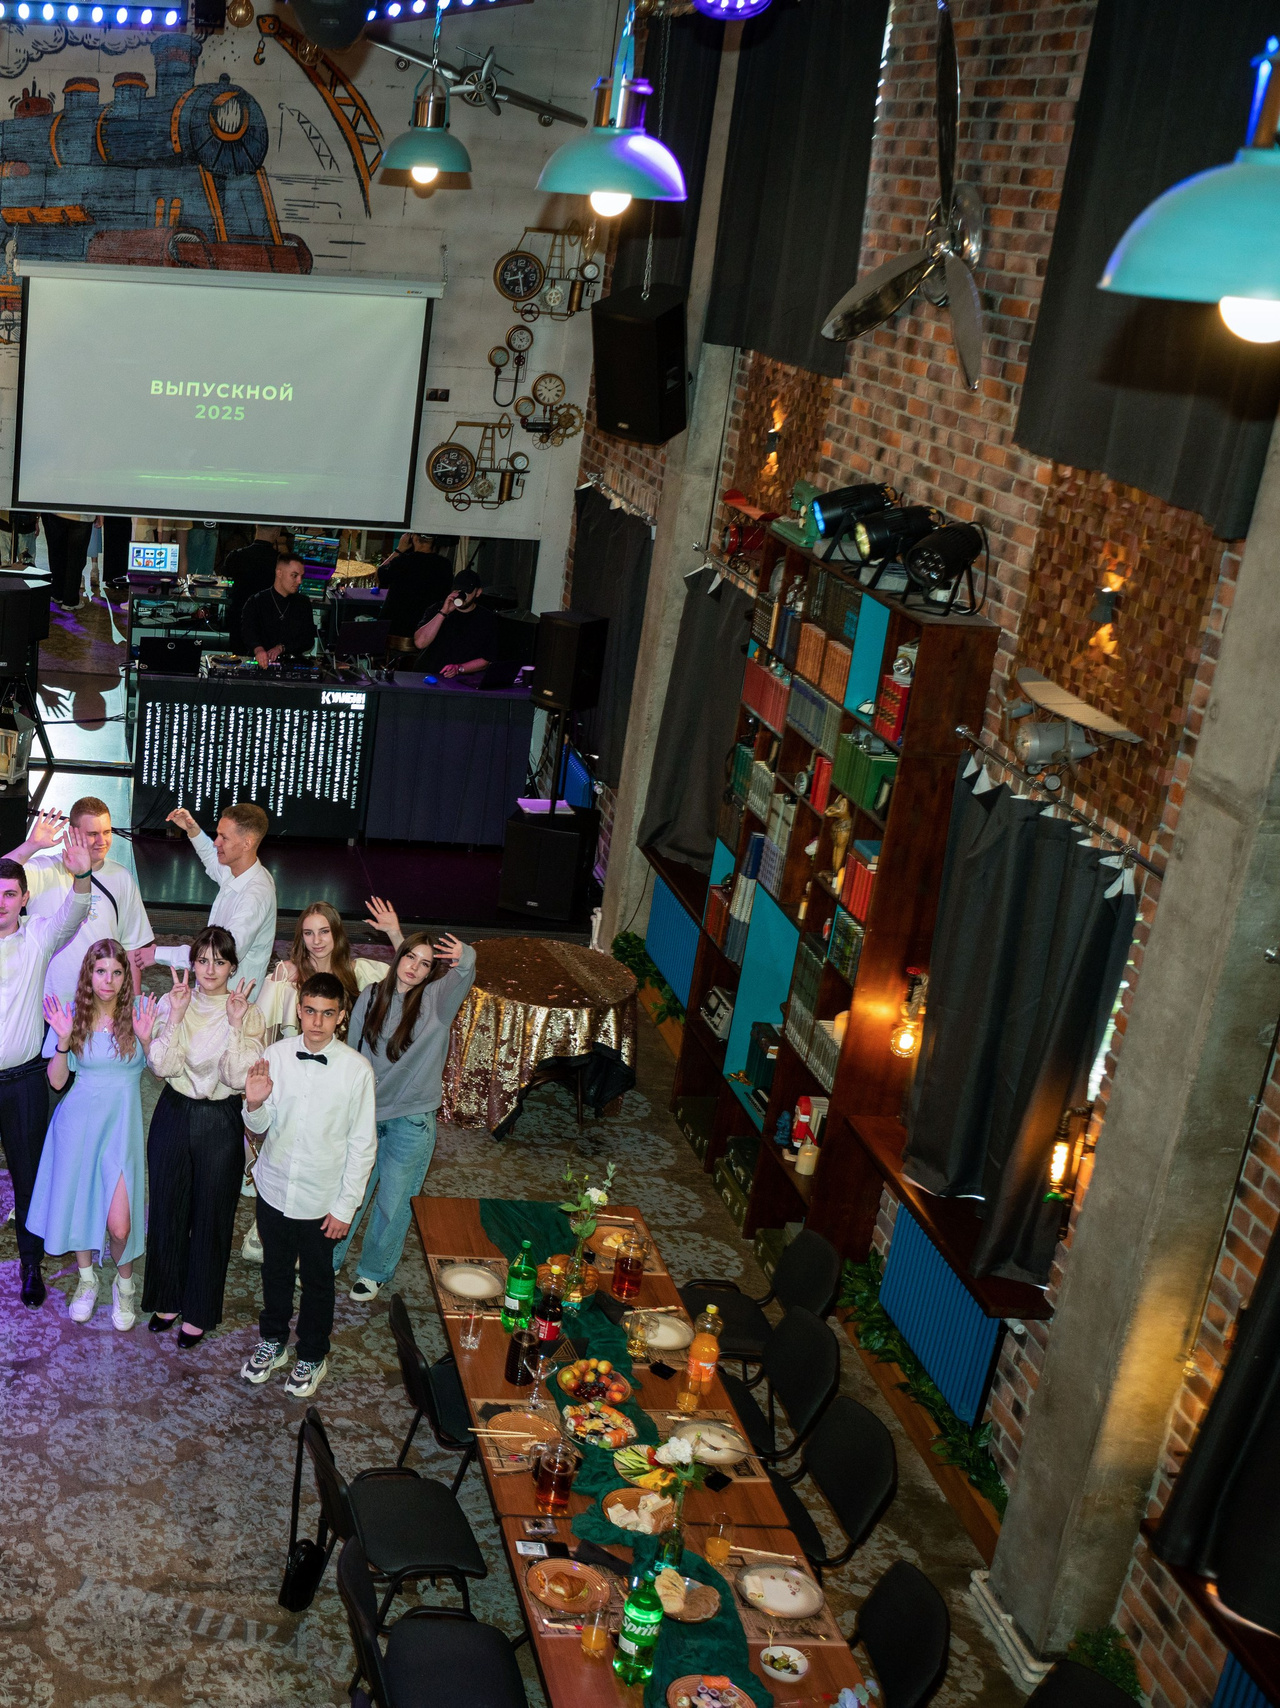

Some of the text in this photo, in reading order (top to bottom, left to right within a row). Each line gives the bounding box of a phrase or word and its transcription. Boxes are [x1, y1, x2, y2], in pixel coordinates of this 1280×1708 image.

[150, 379, 294, 402] ВЫПУСКНОЙ
[194, 404, 245, 421] 2025
[622, 1615, 661, 1637] Sprite
